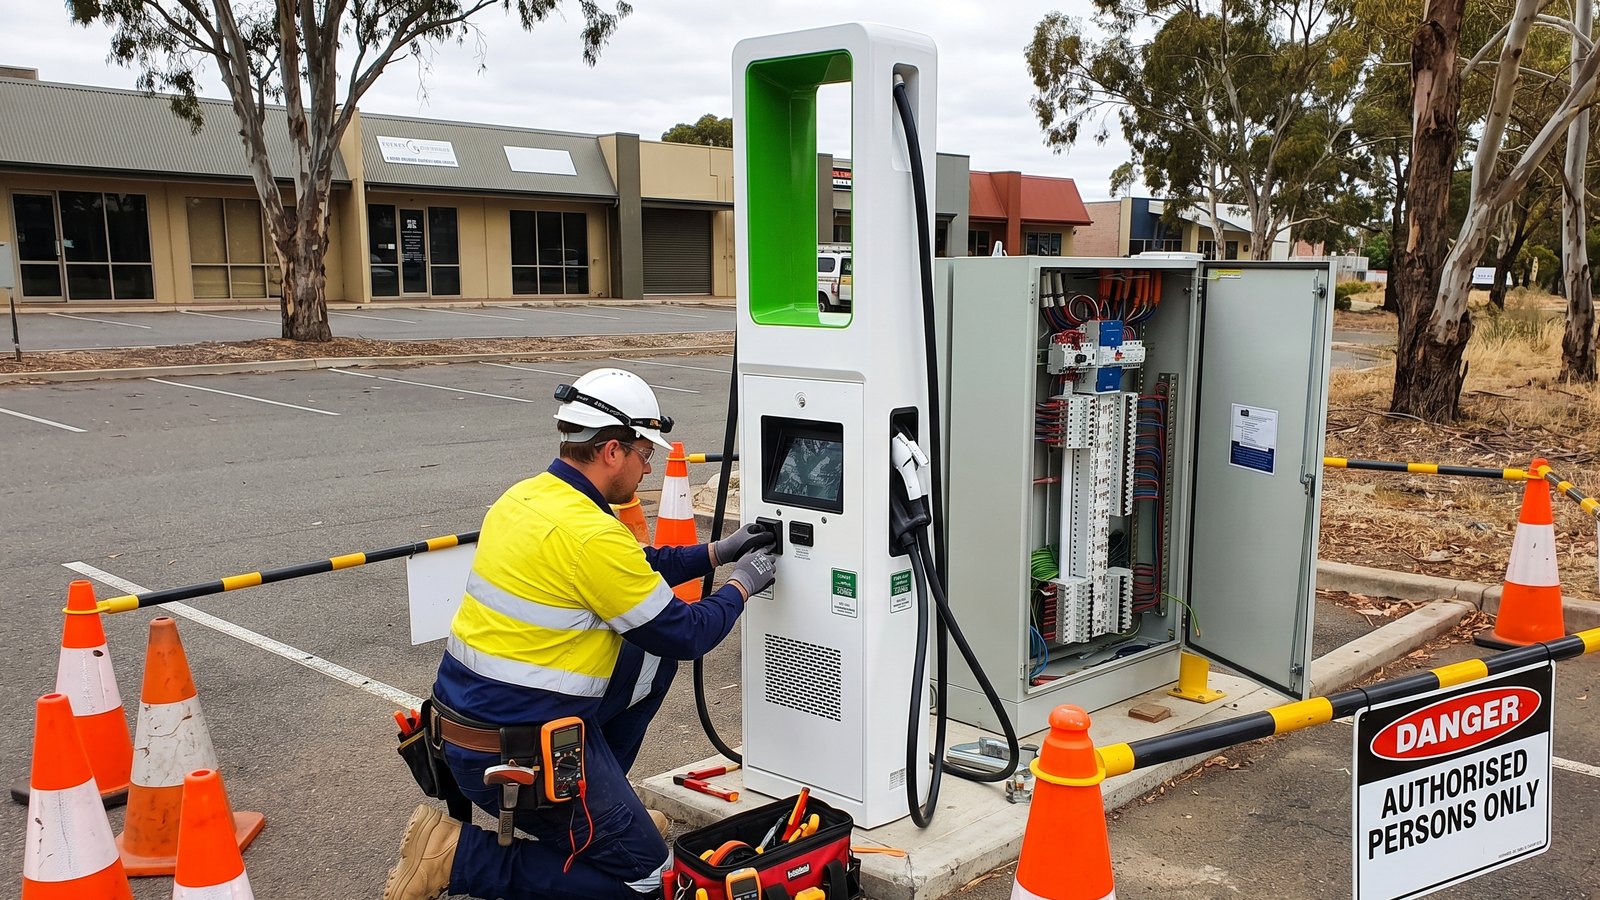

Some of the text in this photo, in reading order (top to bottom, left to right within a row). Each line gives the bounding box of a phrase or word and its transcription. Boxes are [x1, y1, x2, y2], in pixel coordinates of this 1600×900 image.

[1396, 695, 1519, 753] DANGER
[1368, 778, 1540, 860] PERSONS ONLY
[1381, 748, 1528, 819] AUTHORISED
